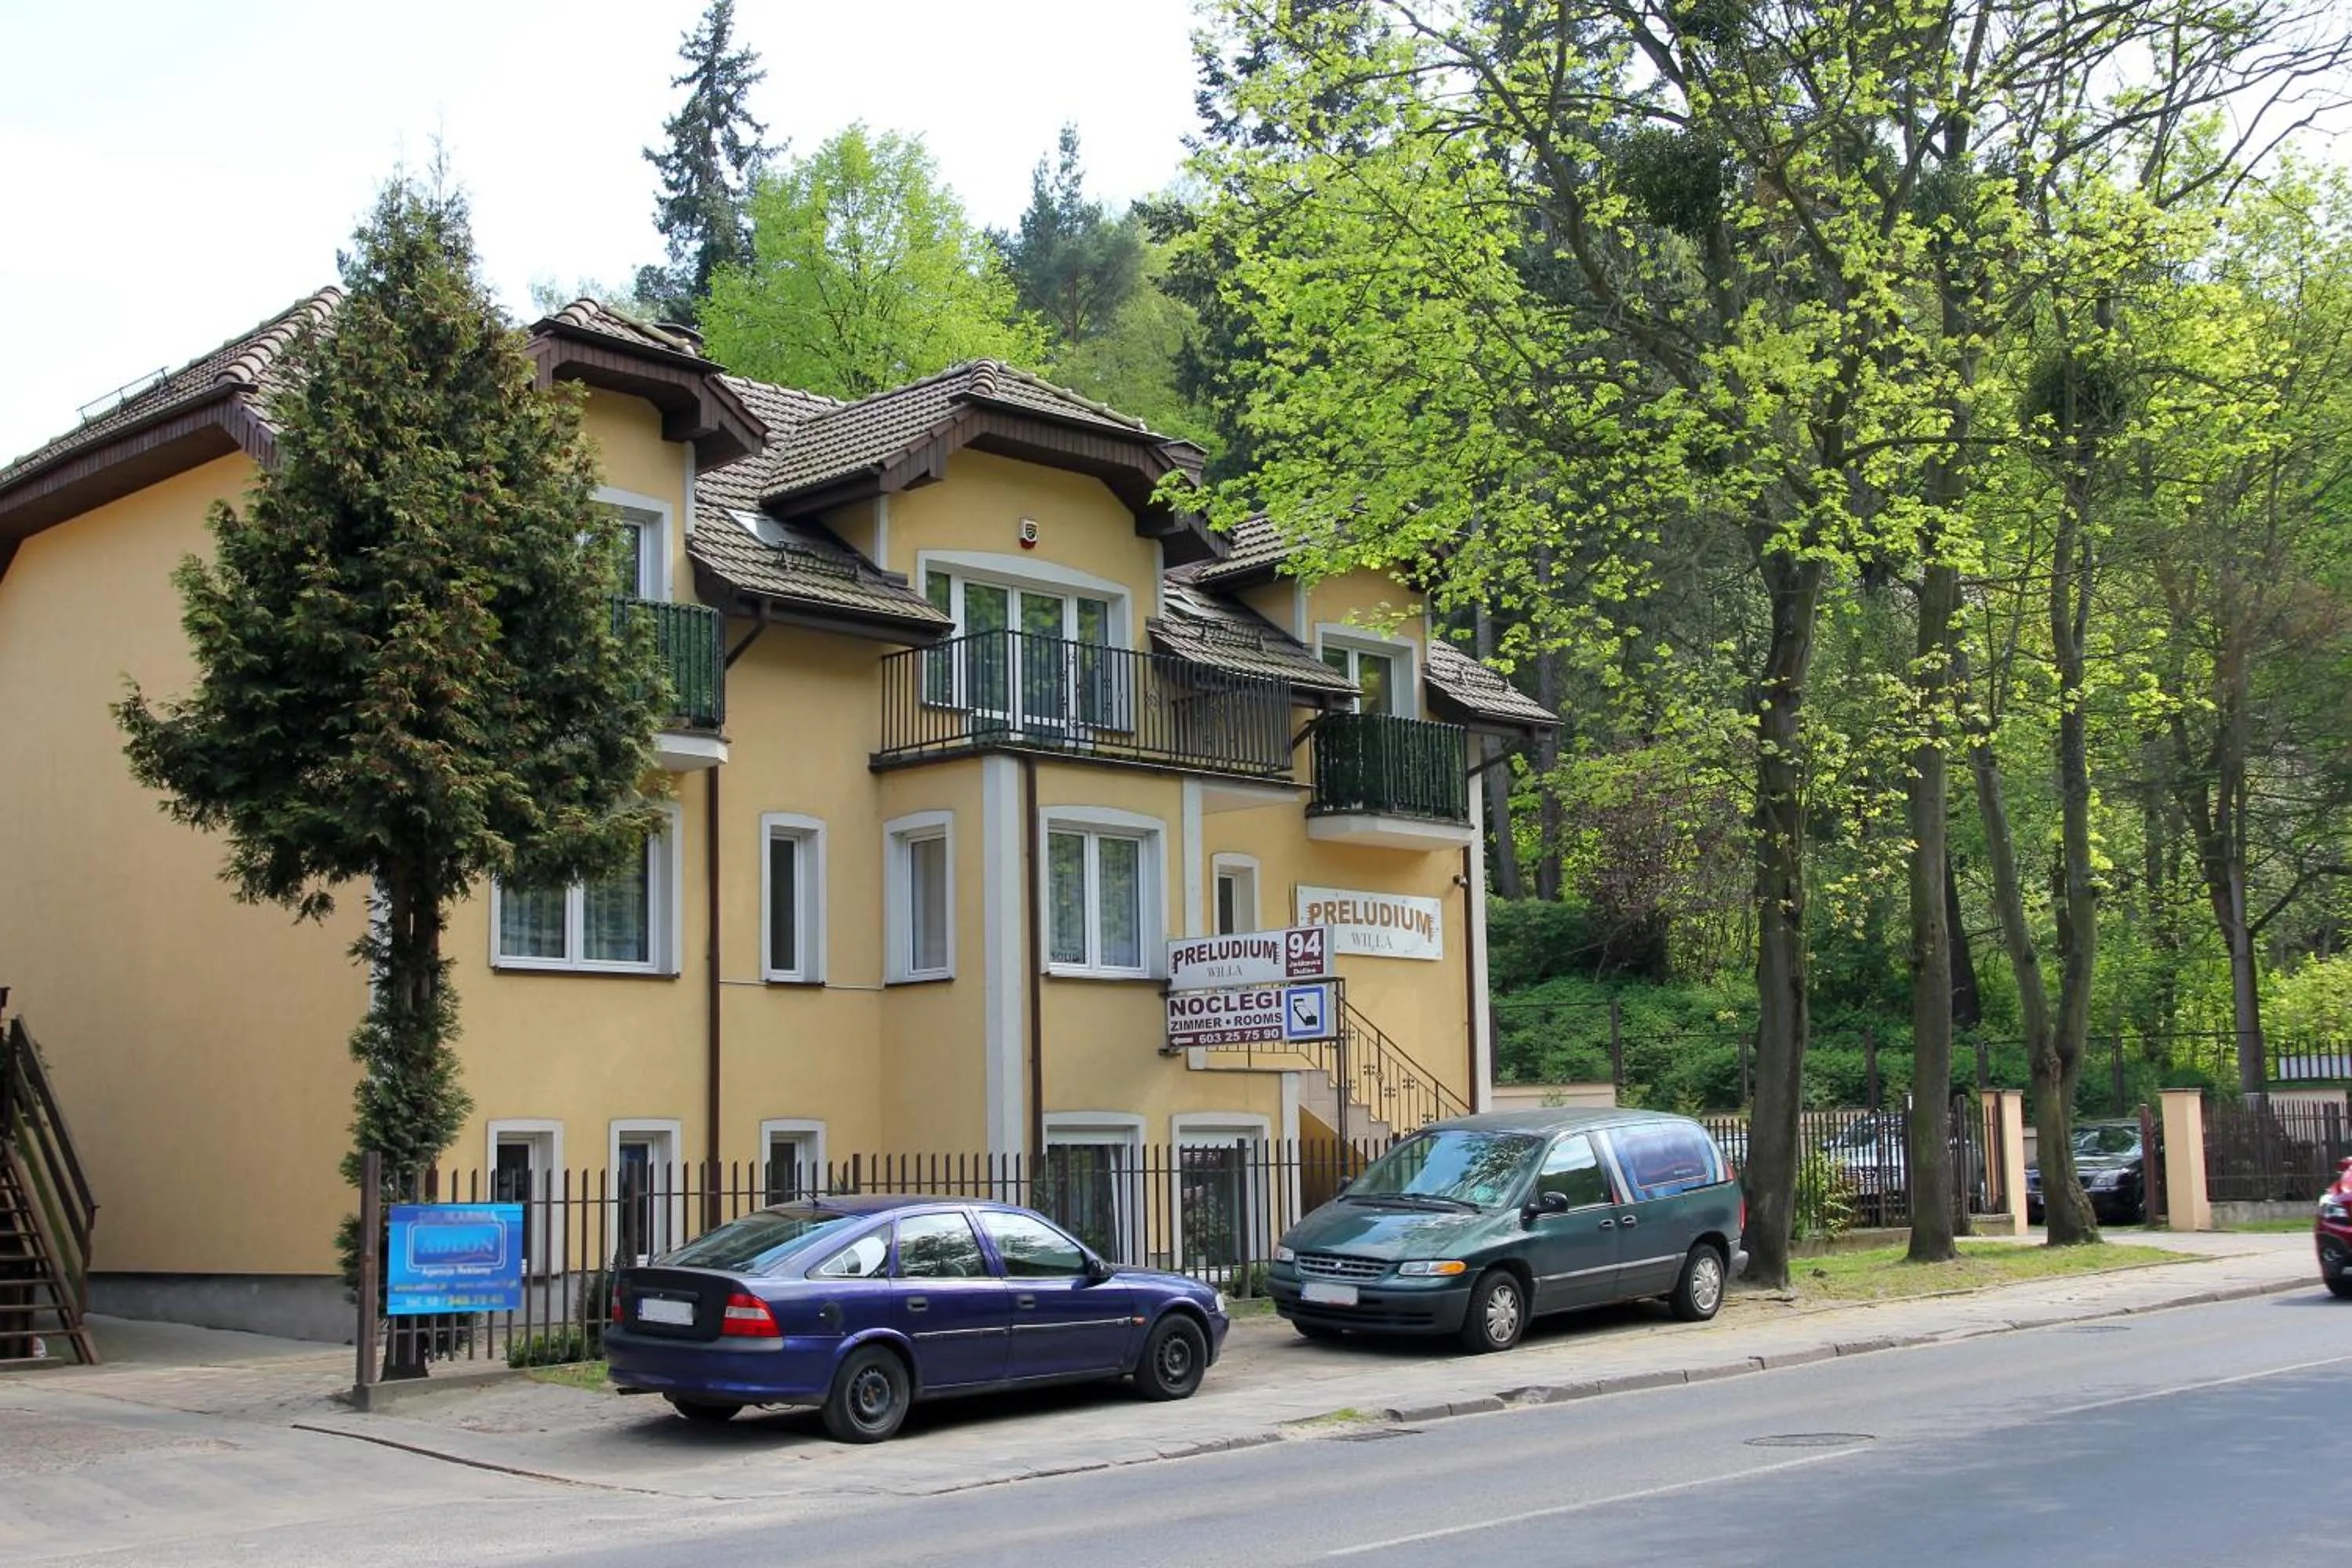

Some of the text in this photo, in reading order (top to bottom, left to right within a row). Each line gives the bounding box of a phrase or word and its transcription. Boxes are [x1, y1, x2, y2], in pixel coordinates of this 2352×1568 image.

[1306, 900, 1434, 942] PRELUDIUM
[1288, 931, 1321, 959] 94
[1351, 932, 1392, 949] WILLA
[1172, 940, 1279, 974] PRELUDIUM
[1207, 965, 1243, 978] WILLA
[1169, 990, 1282, 1017] NOCLEGI
[1171, 1012, 1283, 1032] ZIMMER ROOMS
[1199, 1028, 1279, 1044] 603 25 75 90
